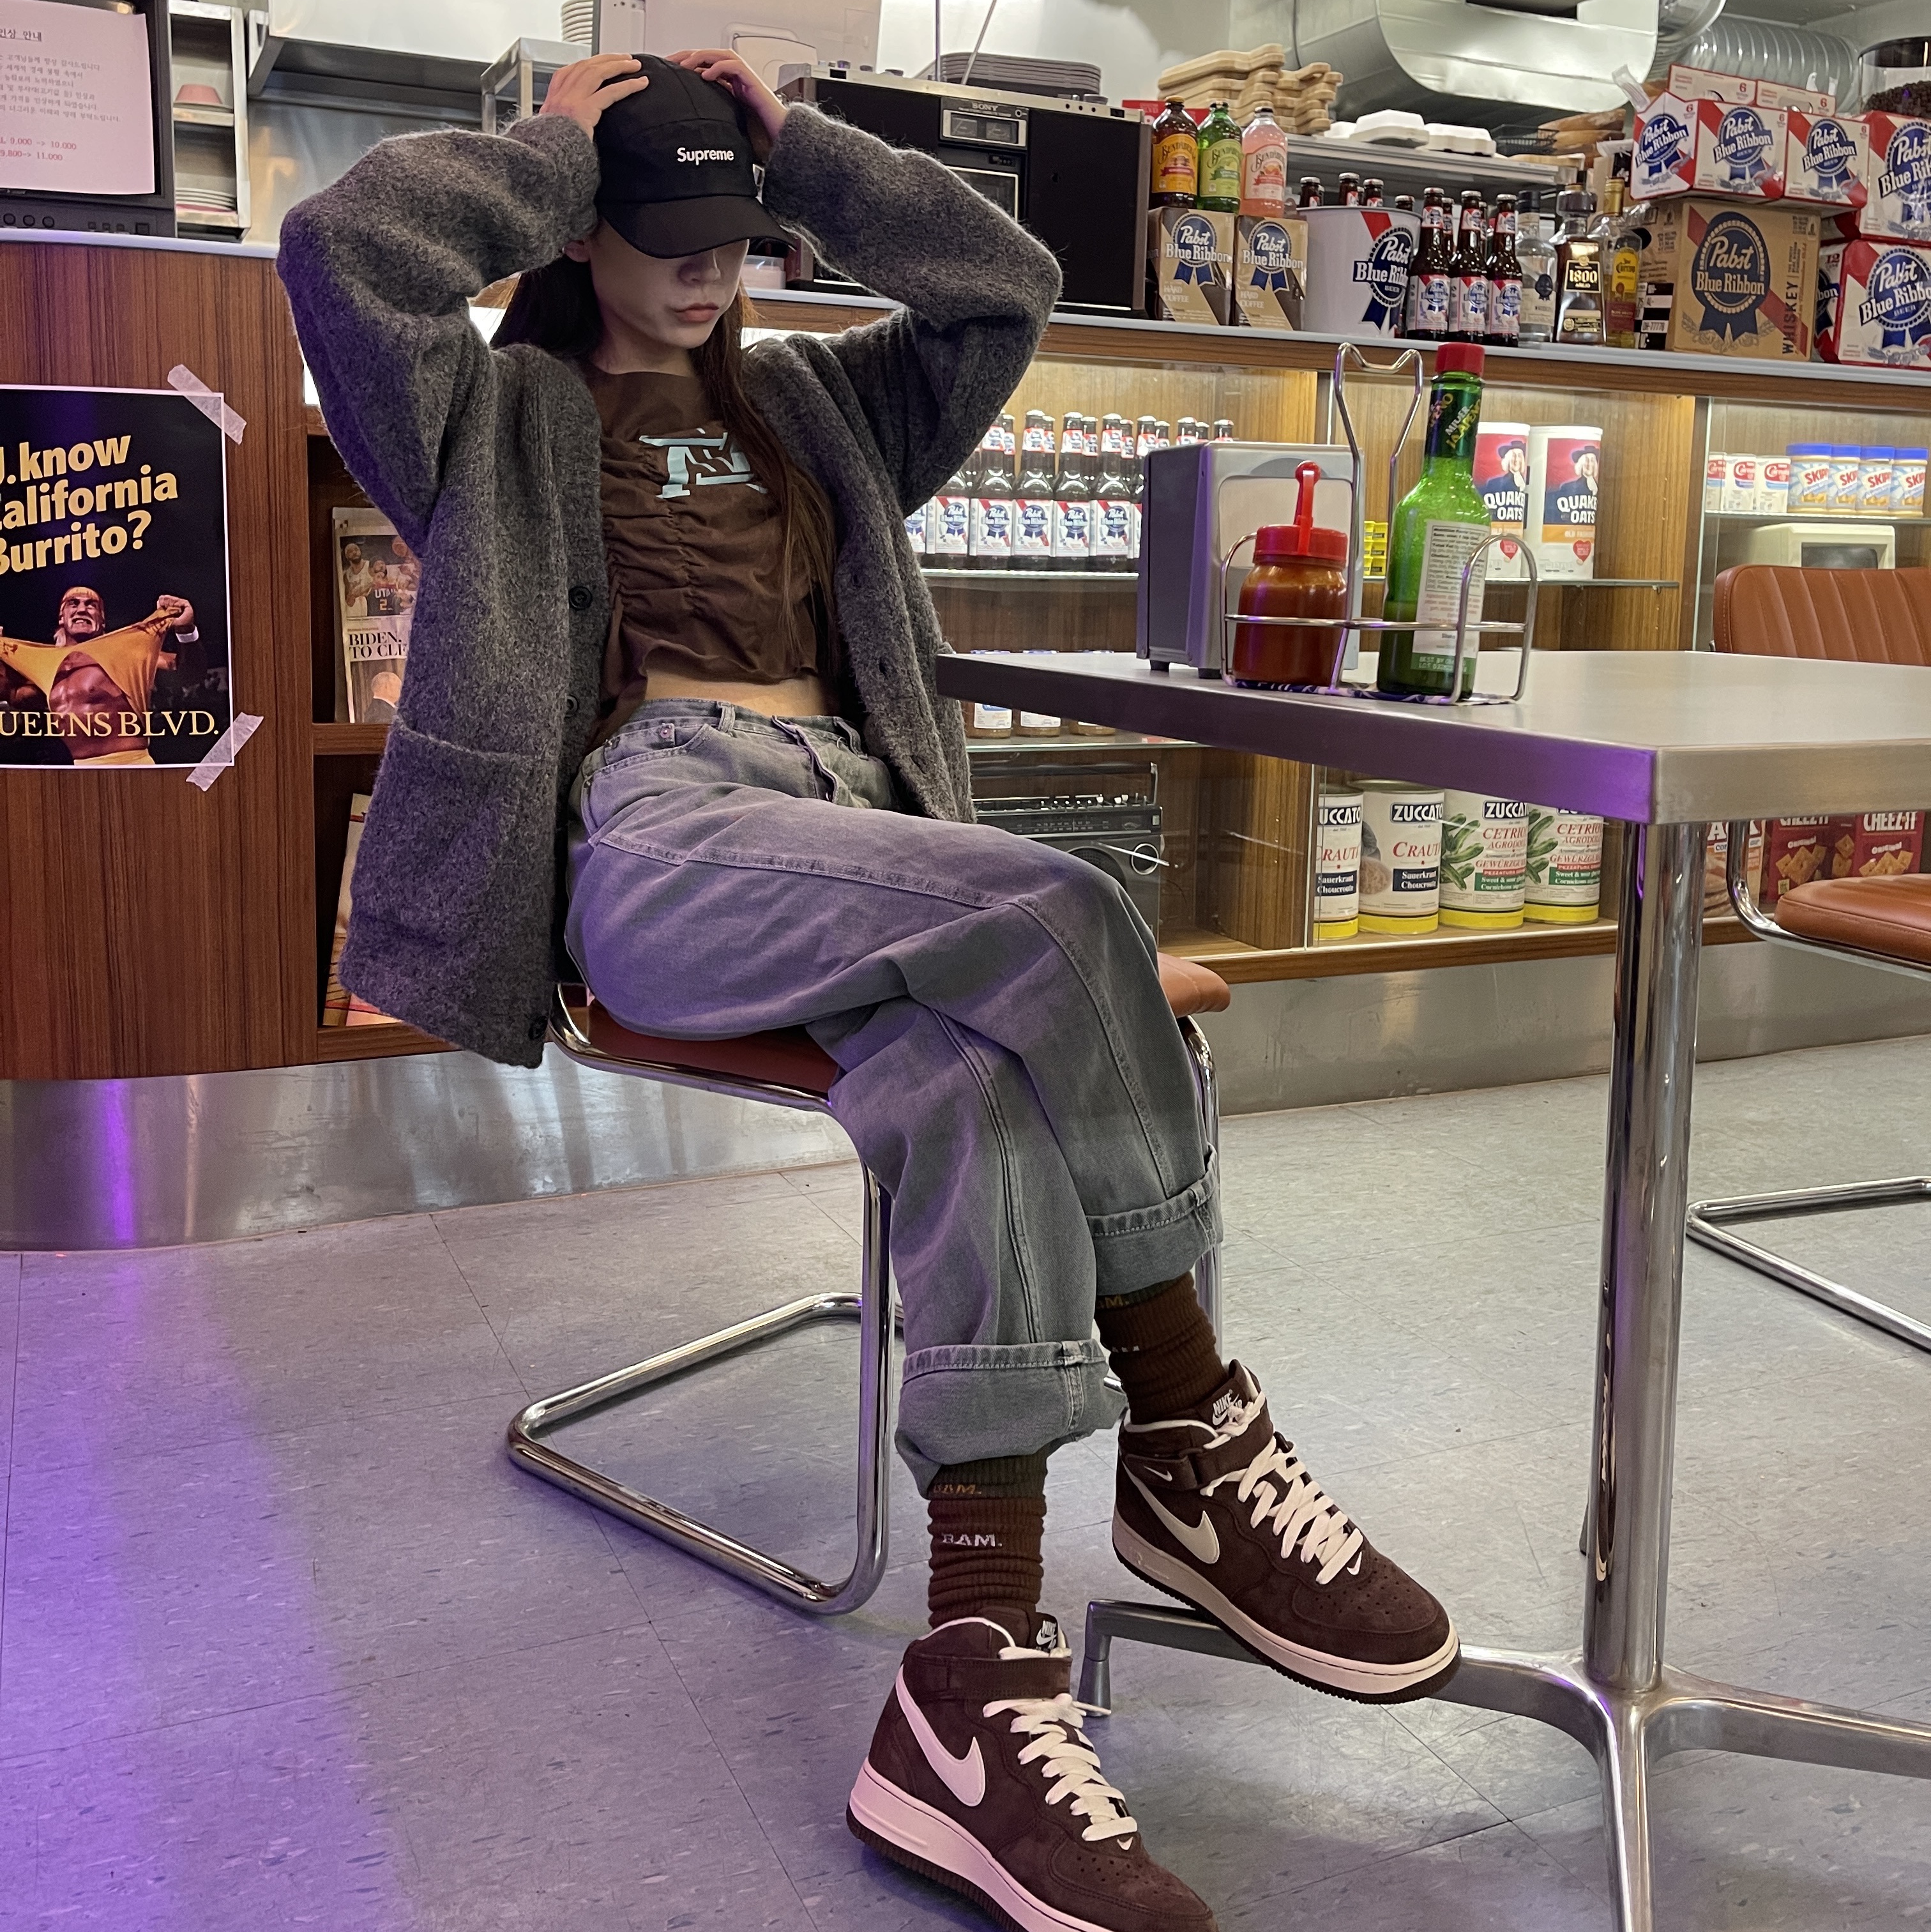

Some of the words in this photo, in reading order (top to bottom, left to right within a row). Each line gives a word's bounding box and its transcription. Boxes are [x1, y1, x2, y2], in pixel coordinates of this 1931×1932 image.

[972, 102, 998, 111] SONY
[1644, 119, 1669, 145] Pabst
[1723, 116, 1754, 139] Pabst
[1812, 128, 1838, 149] Pabst
[677, 147, 734, 165] Supreme
[1636, 146, 1653, 168] Blue
[1653, 128, 1687, 151] Ribbon
[1715, 142, 1736, 163] Blue
[1735, 133, 1771, 151] Ribbon
[1804, 152, 1824, 171] Blue
[1822, 144, 1856, 161] Ribbon
[1881, 171, 1911, 196] Blue
[1181, 225, 1210, 245] Pabst
[1257, 232, 1287, 252] Pabst
[1166, 243, 1191, 260] Blue
[1193, 244, 1233, 264] Ribbon
[1243, 250, 1267, 266] Blue
[1268, 250, 1304, 270] Ribbon
[1709, 236, 1754, 270] Pabst
[1355, 262, 1388, 283] Blue
[1569, 269, 1598, 284] 1800
[1695, 271, 1722, 292] Blue
[1723, 273, 1765, 295] Ribbon
[1876, 261, 1918, 293] Pabst
[1782, 281, 1798, 354] WHISKEY
[1861, 298, 1894, 324] Blue
[1497, 506, 1524, 521] OATS
[1570, 510, 1595, 524] OATS
[117, 710, 219, 736] BLVD.
[1213, 1392, 1232, 1417] NIKE
